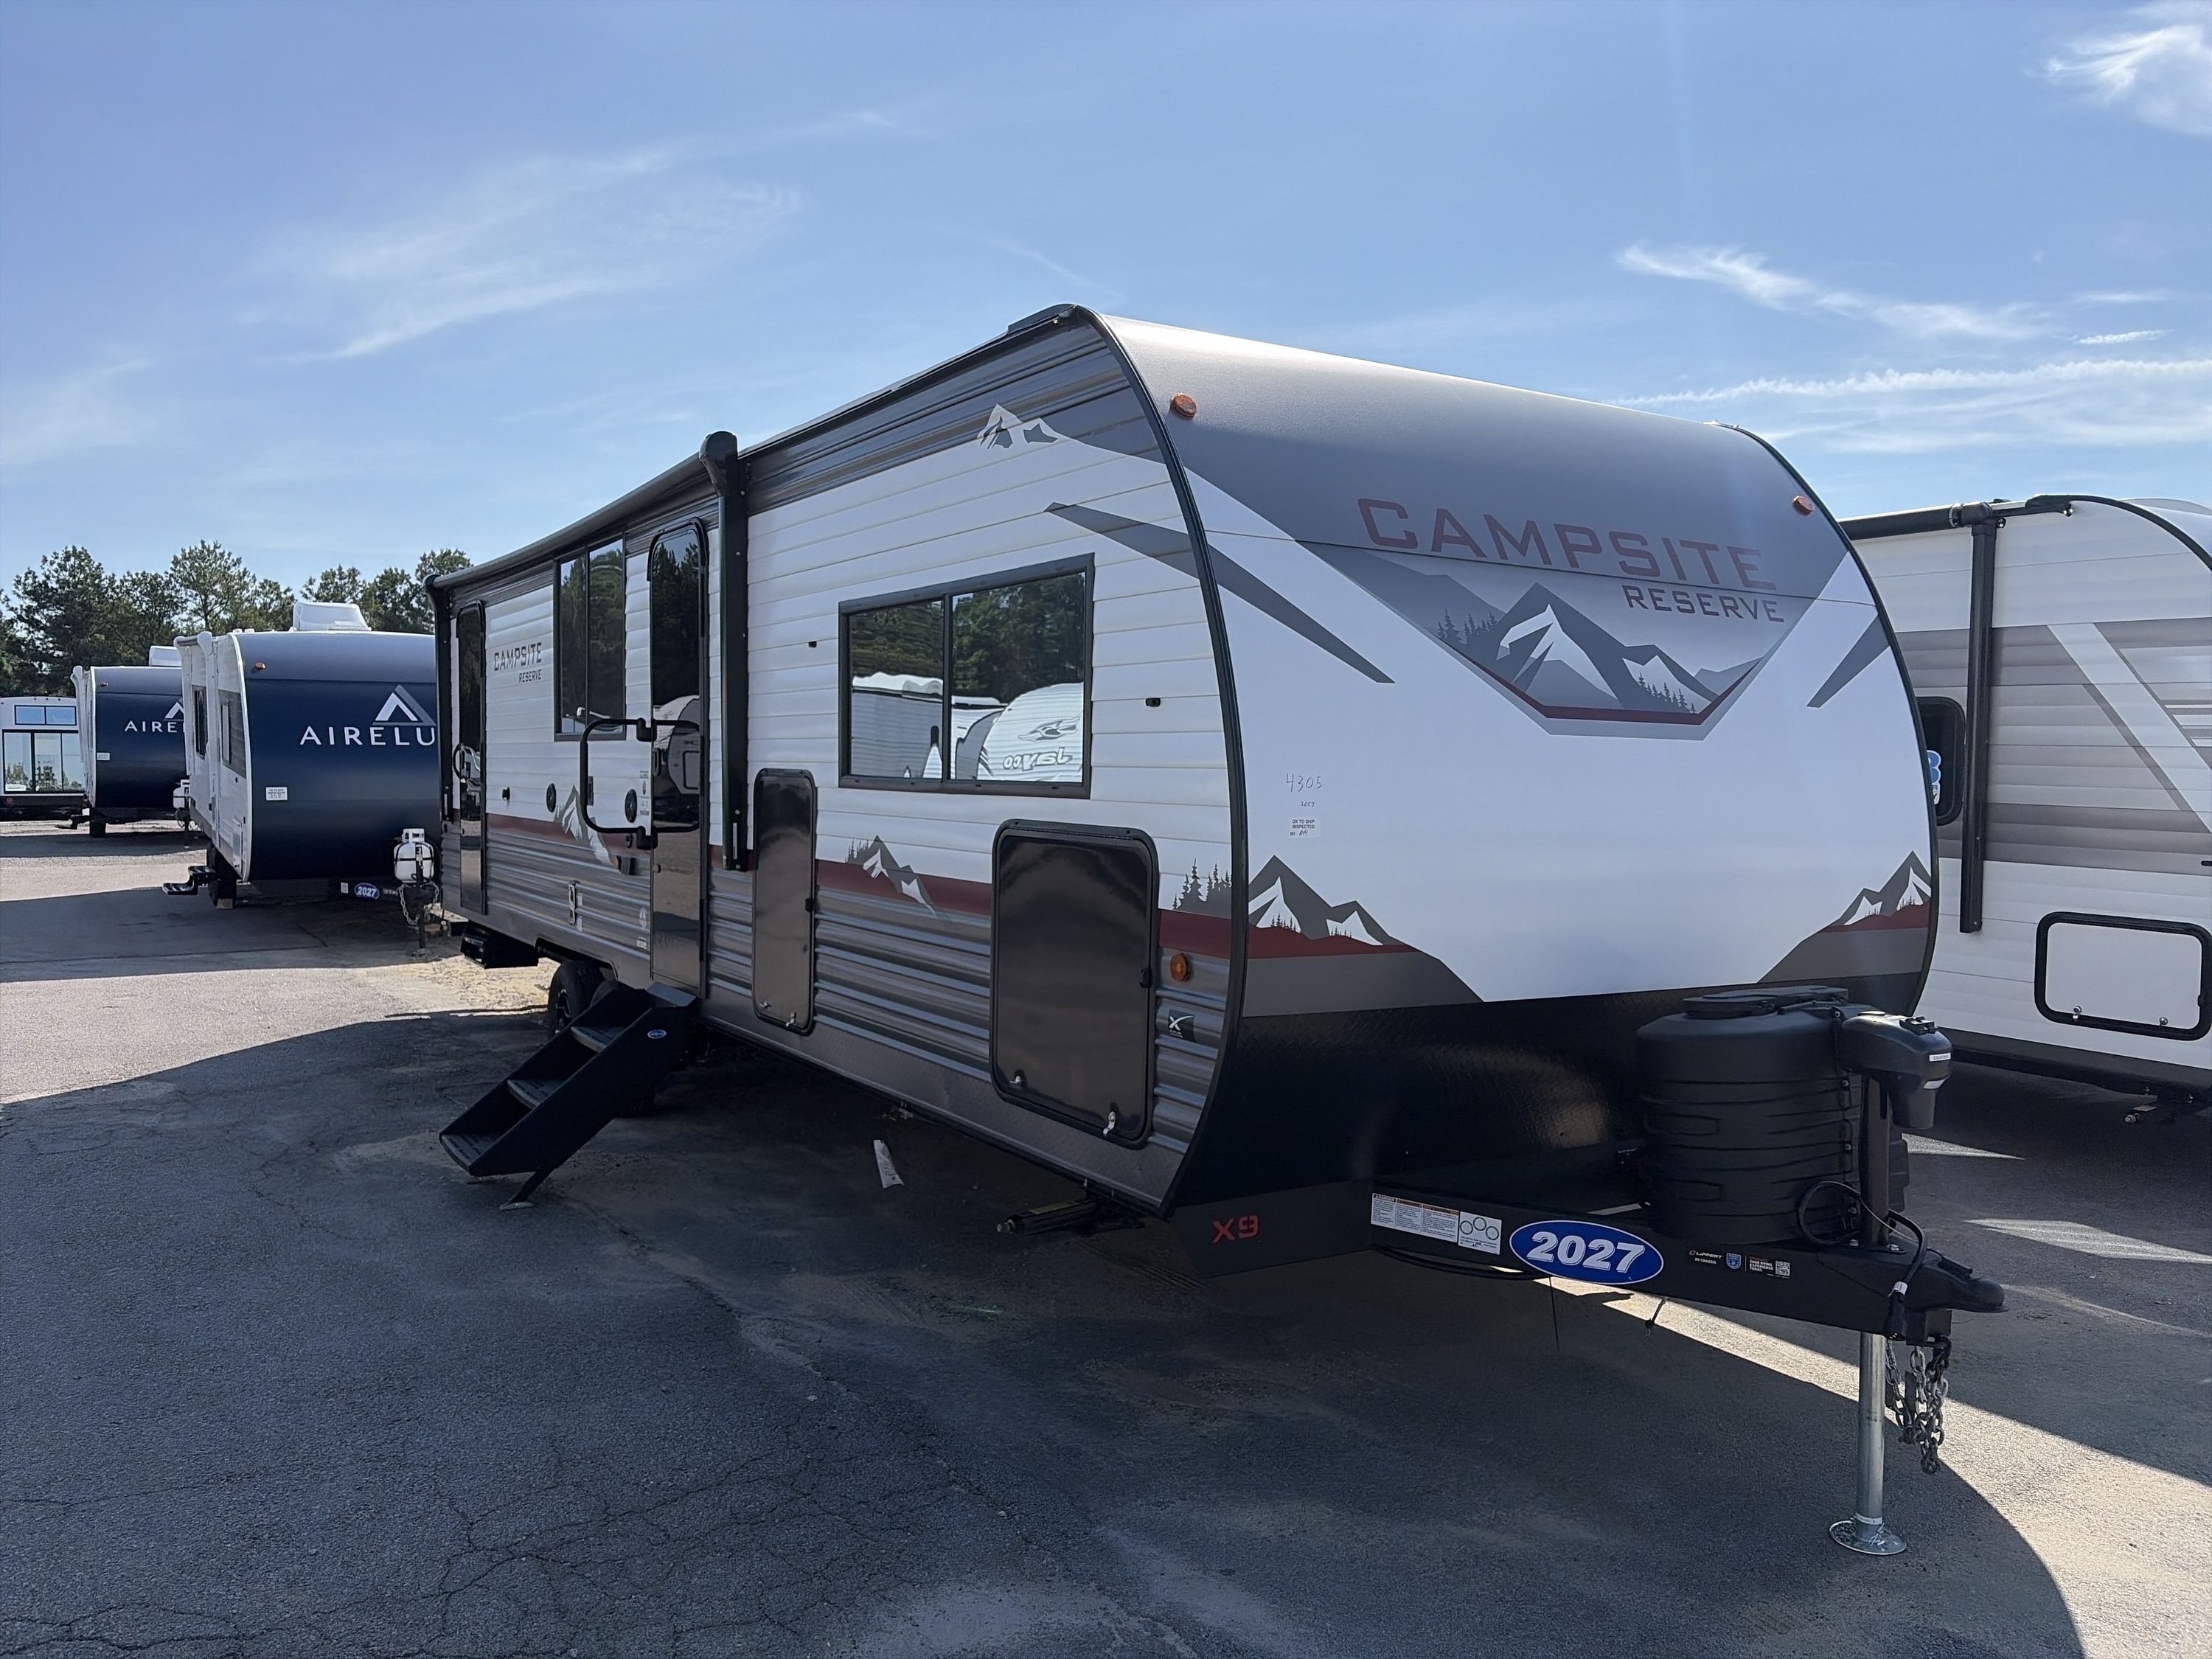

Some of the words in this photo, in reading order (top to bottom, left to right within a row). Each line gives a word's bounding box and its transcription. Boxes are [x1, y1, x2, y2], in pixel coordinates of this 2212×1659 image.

[1357, 497, 1777, 591] CAMPSITE
[1623, 585, 1785, 622] RESERVE
[494, 641, 542, 672] CAMPSITE
[518, 669, 542, 684] RESERVE
[124, 720, 185, 733] AIRE
[299, 726, 436, 745] AIRELU
[1286, 772, 1322, 793] 4305
[357, 886, 377, 897] 2027
[1212, 1214, 1259, 1244] X9
[1526, 1231, 1646, 1273] 2027
[1749, 1263, 1774, 1271] EXPERIENCE
